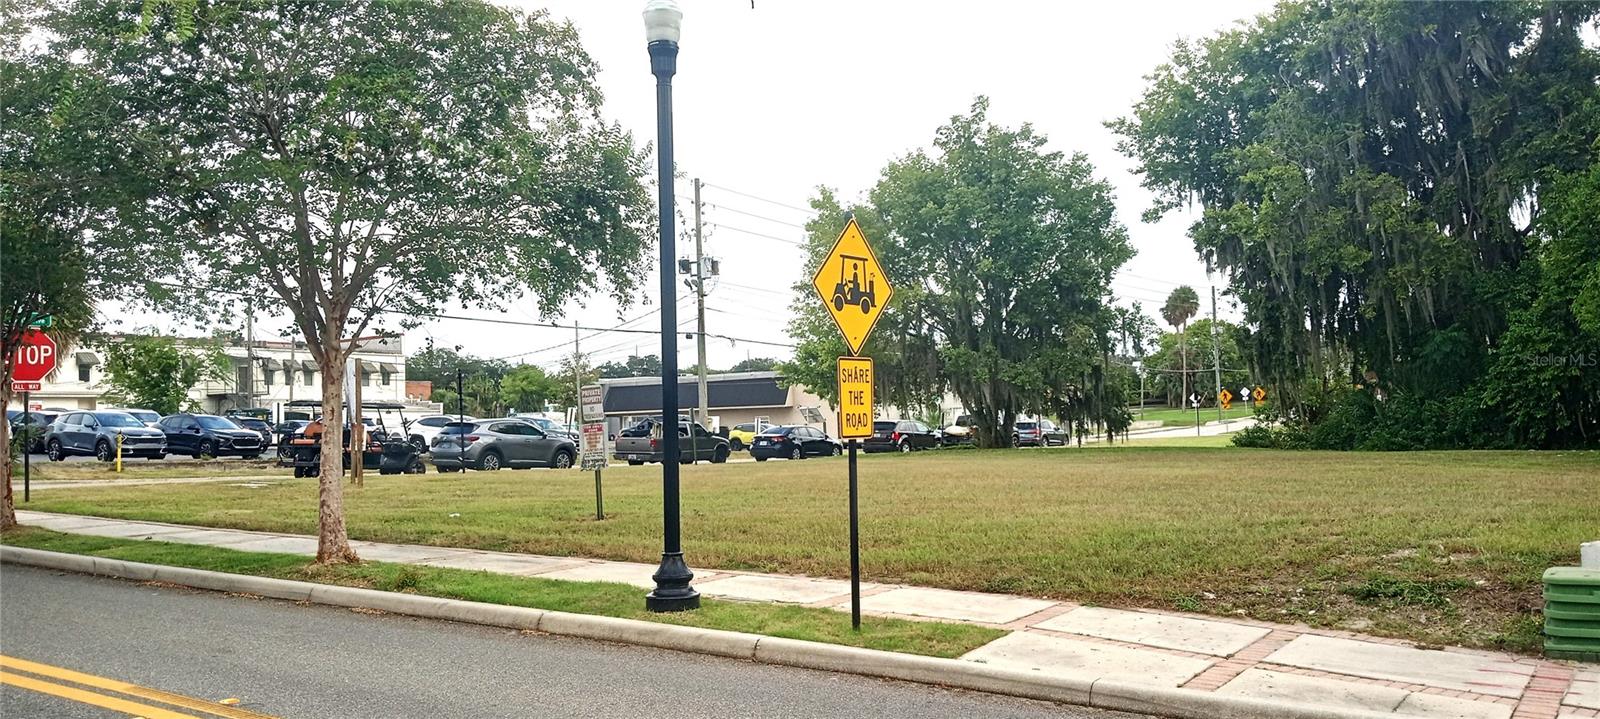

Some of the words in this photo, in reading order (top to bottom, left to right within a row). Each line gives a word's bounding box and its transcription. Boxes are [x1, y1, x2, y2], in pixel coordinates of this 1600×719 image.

[842, 368, 870, 383] SHARE
[582, 389, 601, 397] PRIVATE
[848, 391, 864, 405] THE
[846, 413, 868, 428] ROAD
